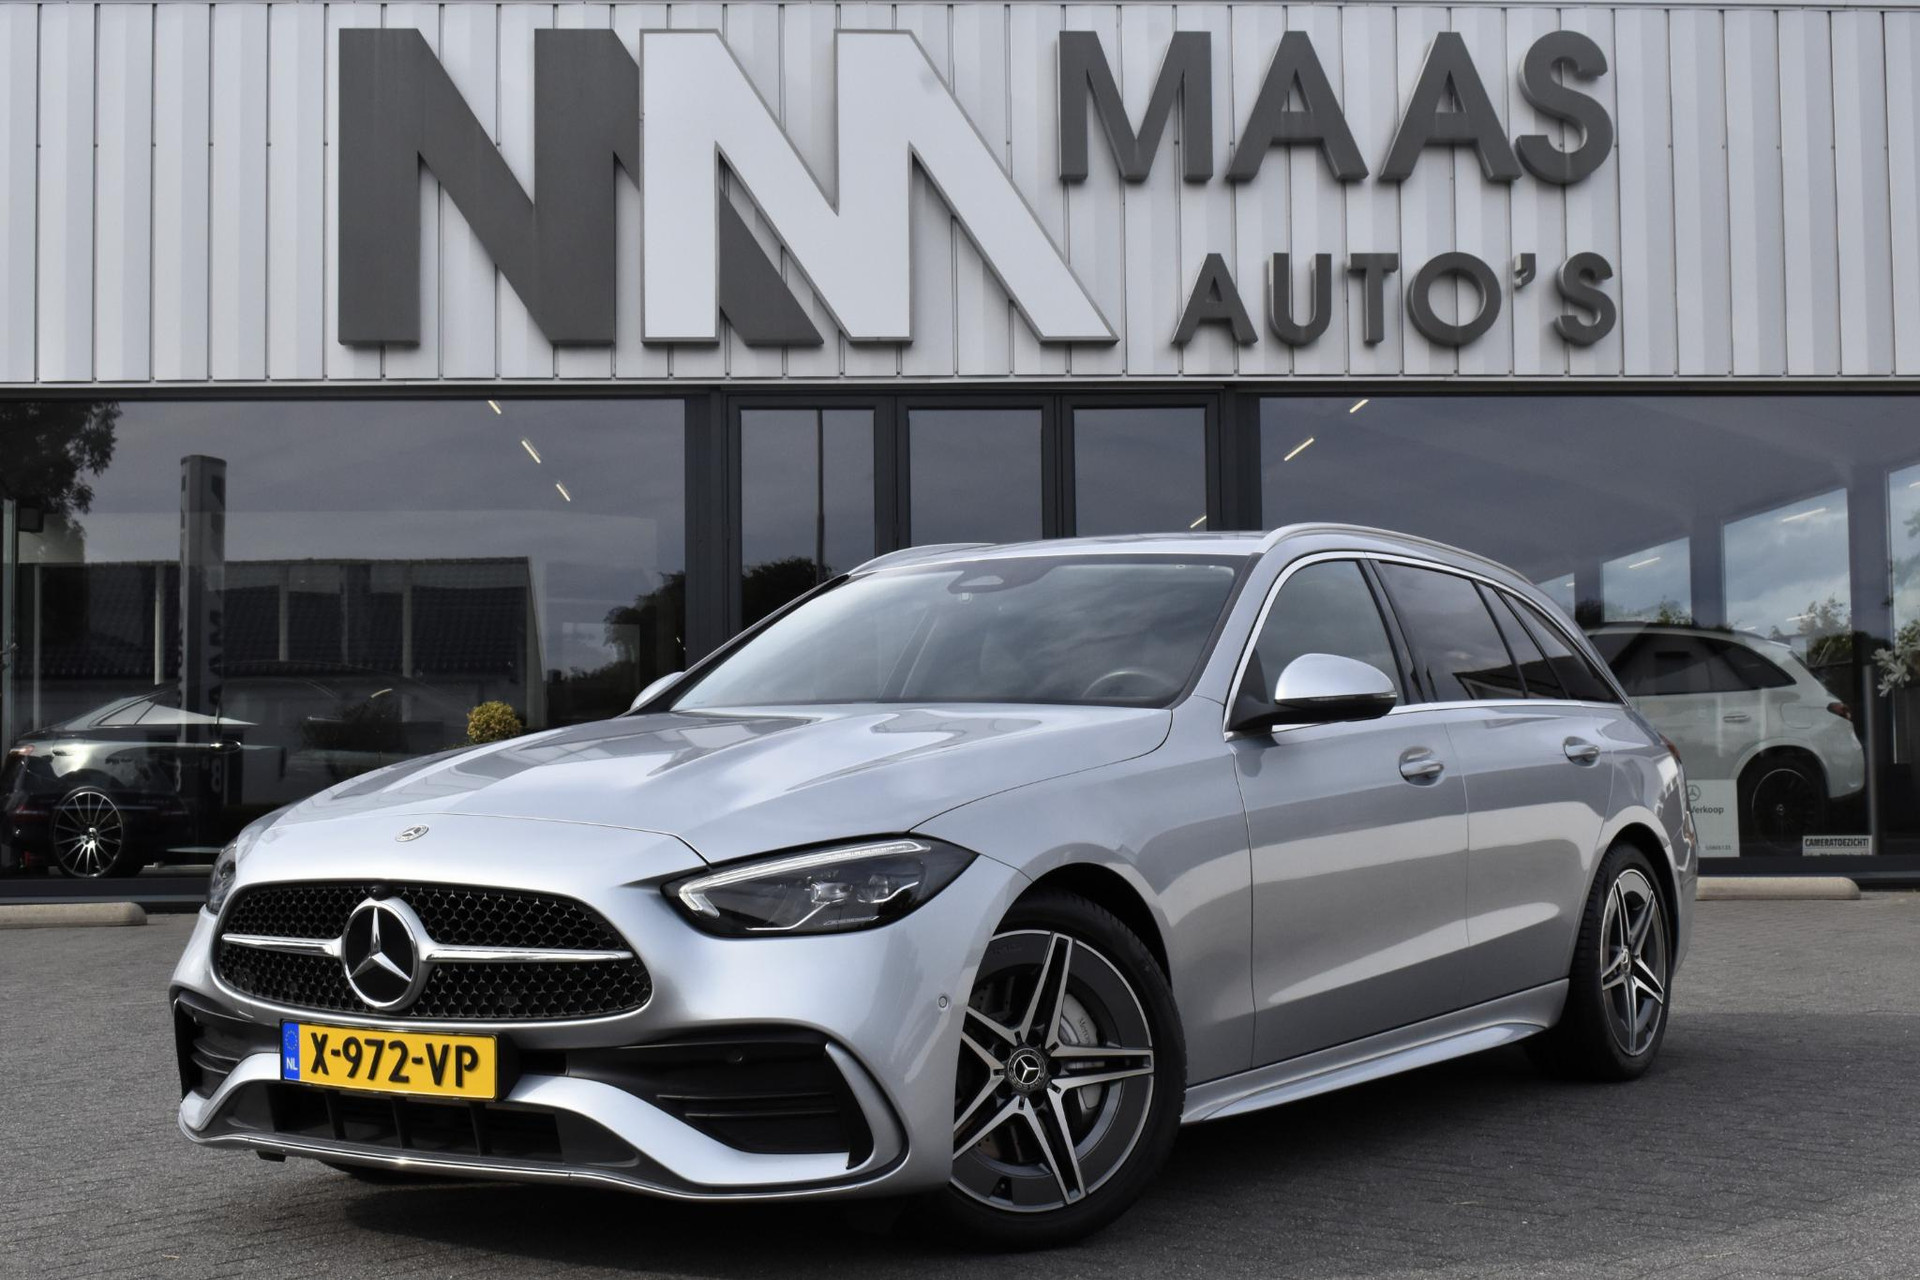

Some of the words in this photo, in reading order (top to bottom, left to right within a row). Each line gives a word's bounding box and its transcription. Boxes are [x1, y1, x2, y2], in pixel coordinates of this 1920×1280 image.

[1057, 30, 1614, 185] MAAS
[1170, 251, 1617, 347] AUTO'S
[286, 1057, 298, 1071] NL
[310, 1032, 480, 1088] X-972-VP
